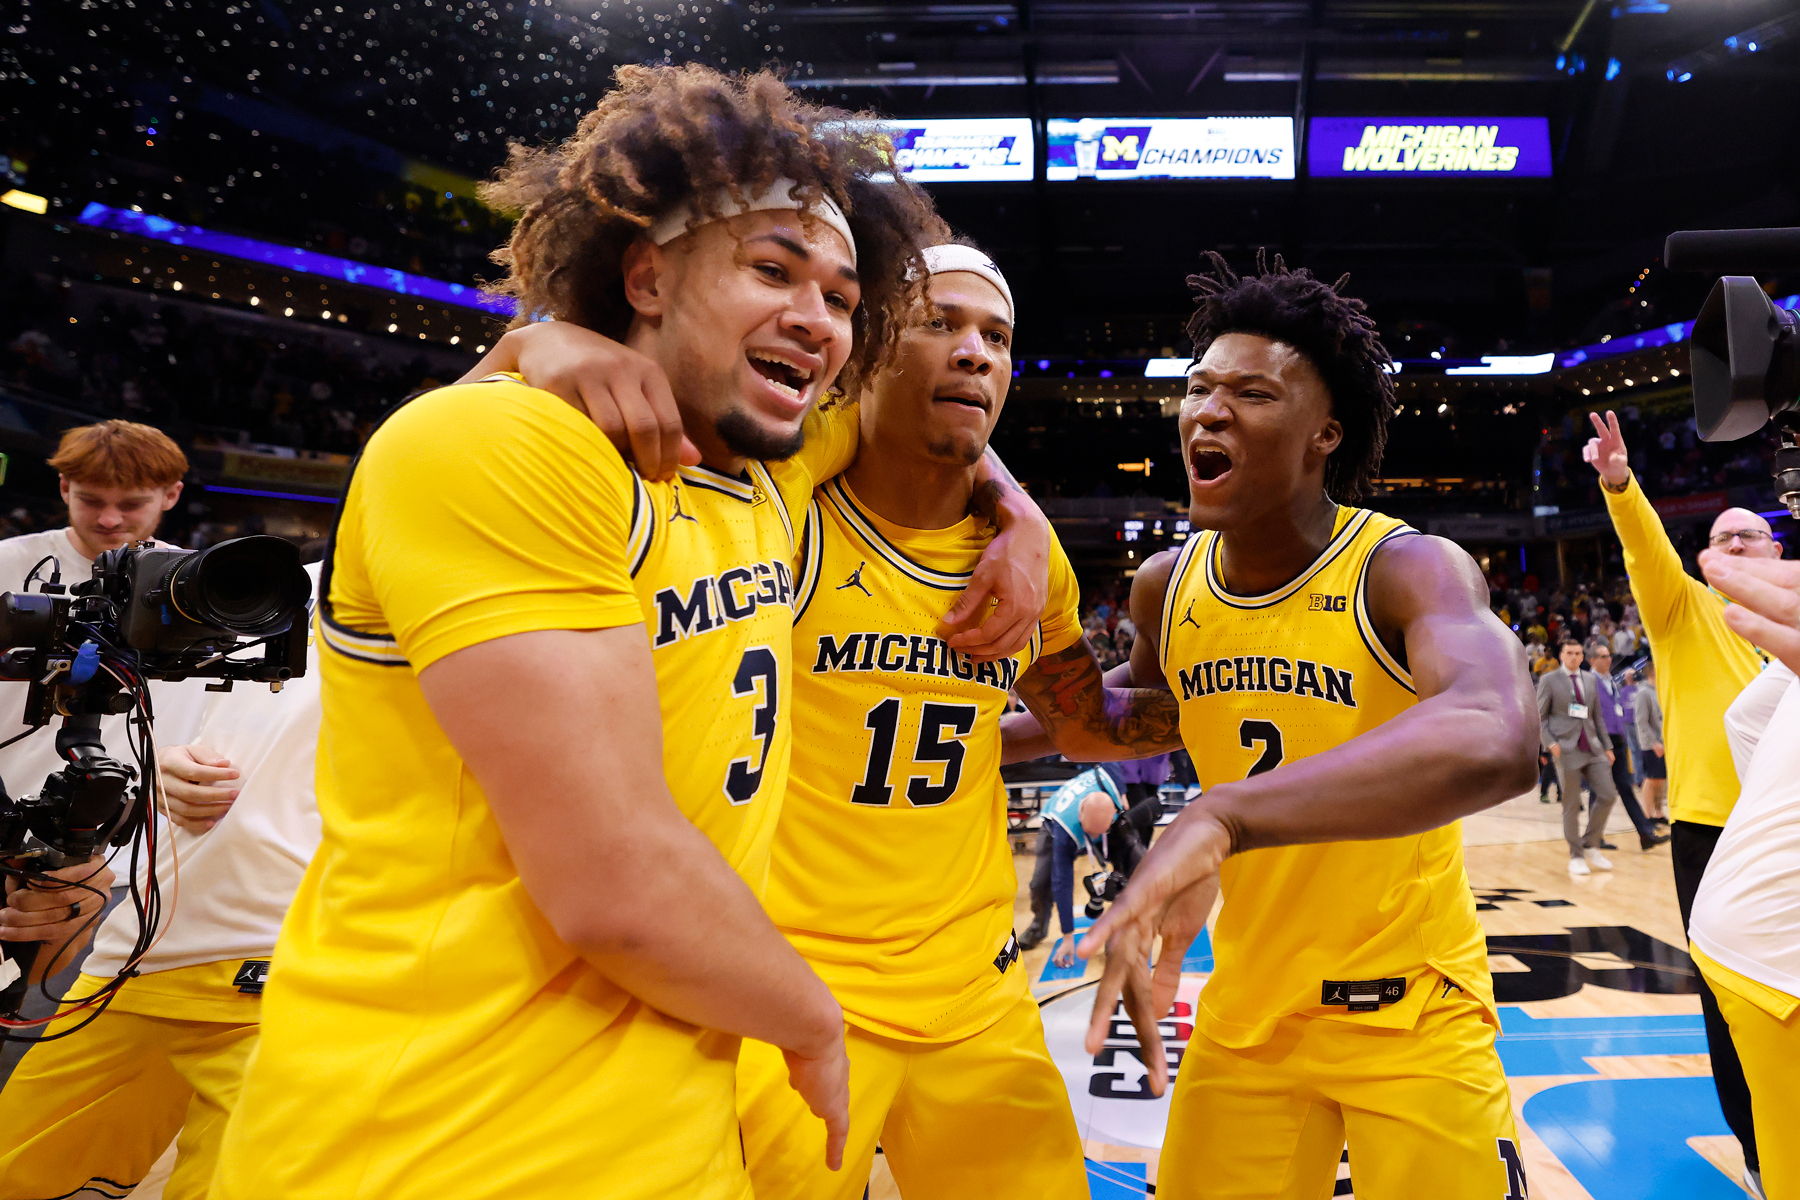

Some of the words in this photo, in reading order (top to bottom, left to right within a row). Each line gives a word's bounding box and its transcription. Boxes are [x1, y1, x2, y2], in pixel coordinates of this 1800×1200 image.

[1102, 135, 1139, 161] M
[1144, 148, 1282, 164] CHAMPIONS
[1359, 125, 1499, 149] MICHIGAN
[1342, 146, 1520, 171] WOLVERINES
[811, 632, 1019, 692] MICHIGAN
[1178, 655, 1359, 710] MICHIGAN
[722, 645, 778, 807] 3
[849, 696, 978, 808] 15
[1238, 718, 1285, 780] 2
[1385, 986, 1399, 997] 46
